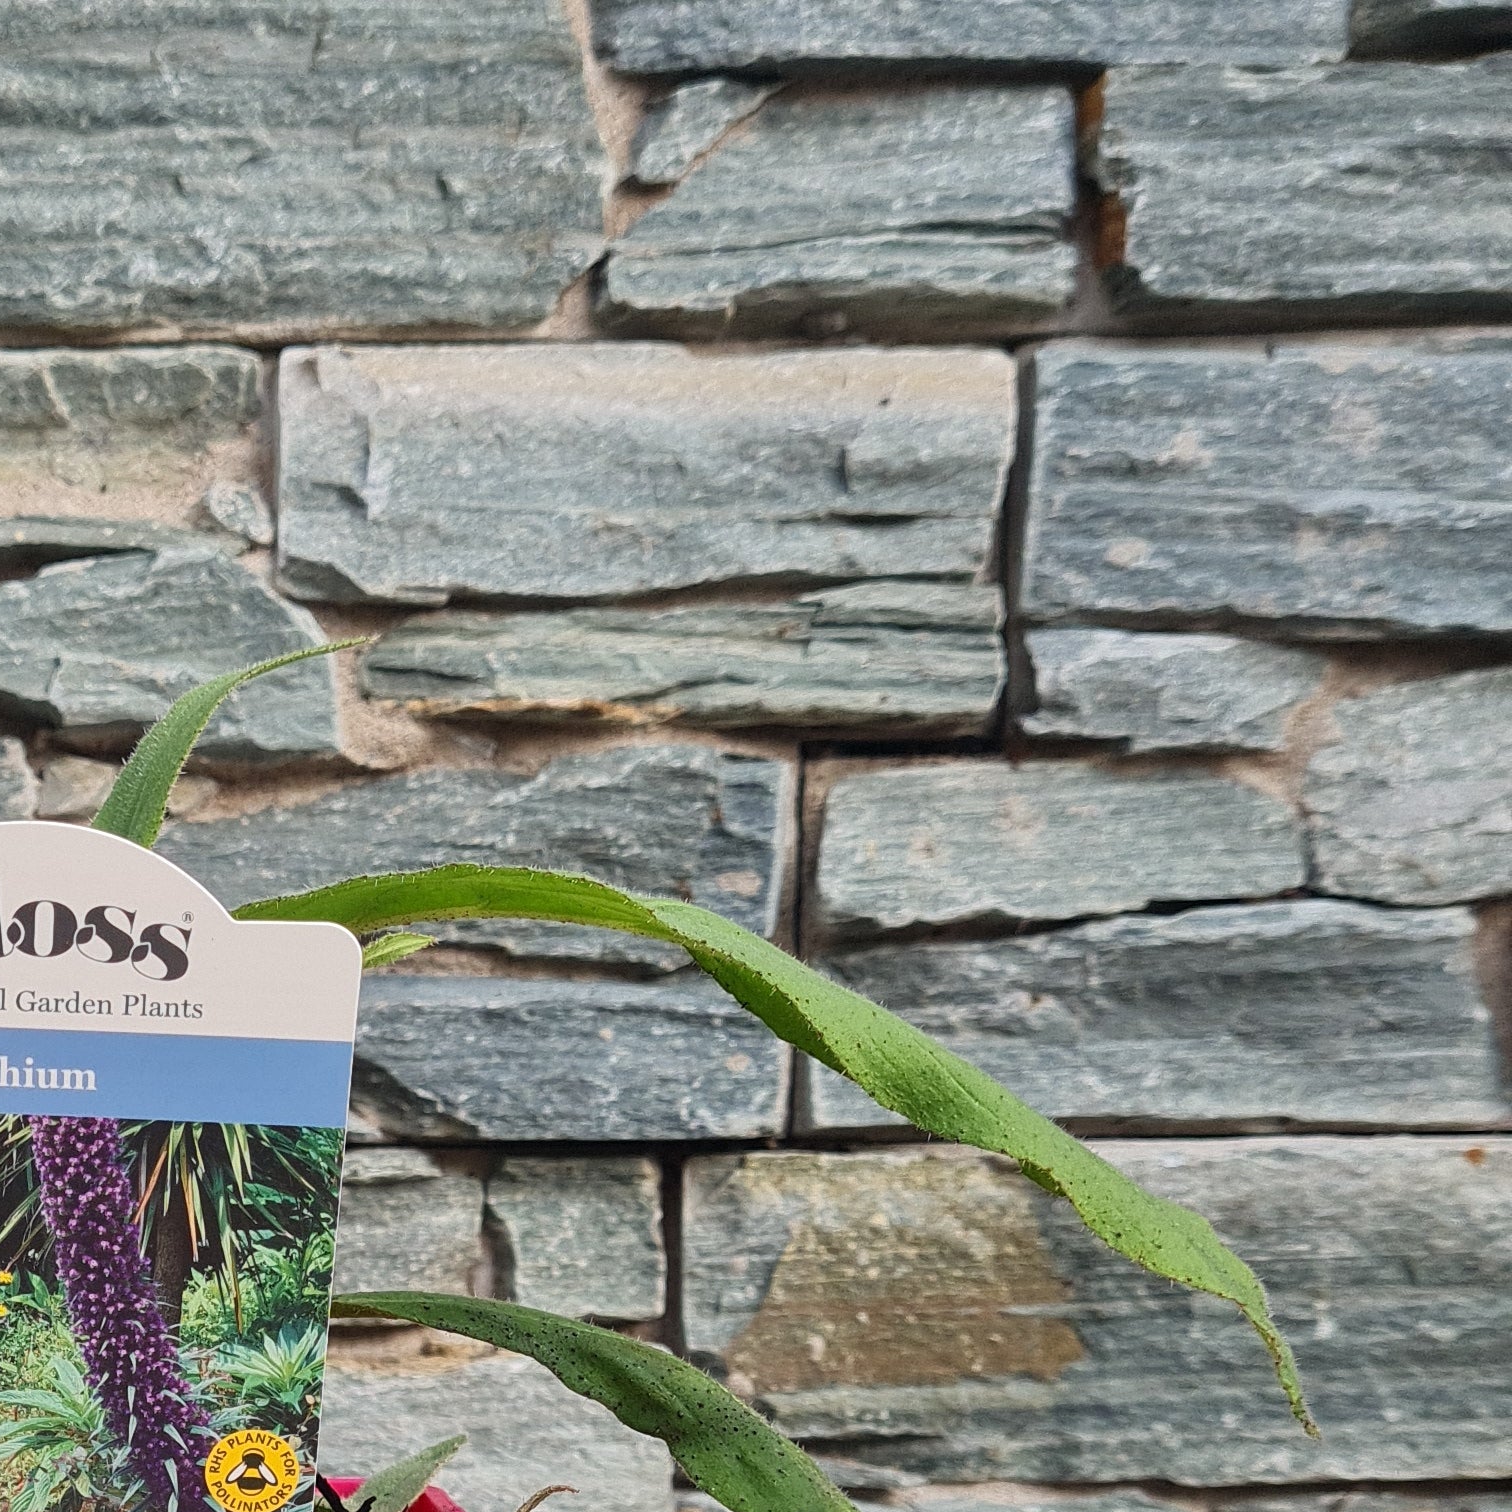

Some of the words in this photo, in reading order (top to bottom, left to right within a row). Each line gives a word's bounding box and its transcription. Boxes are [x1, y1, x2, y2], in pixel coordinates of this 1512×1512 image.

[16, 989, 113, 1015] Garden
[122, 993, 203, 1019] Plants
[209, 1448, 227, 1473] RHS
[226, 1432, 282, 1451] PLANTS
[280, 1451, 296, 1477] FOR
[211, 1480, 293, 1512] POLLINATORS
